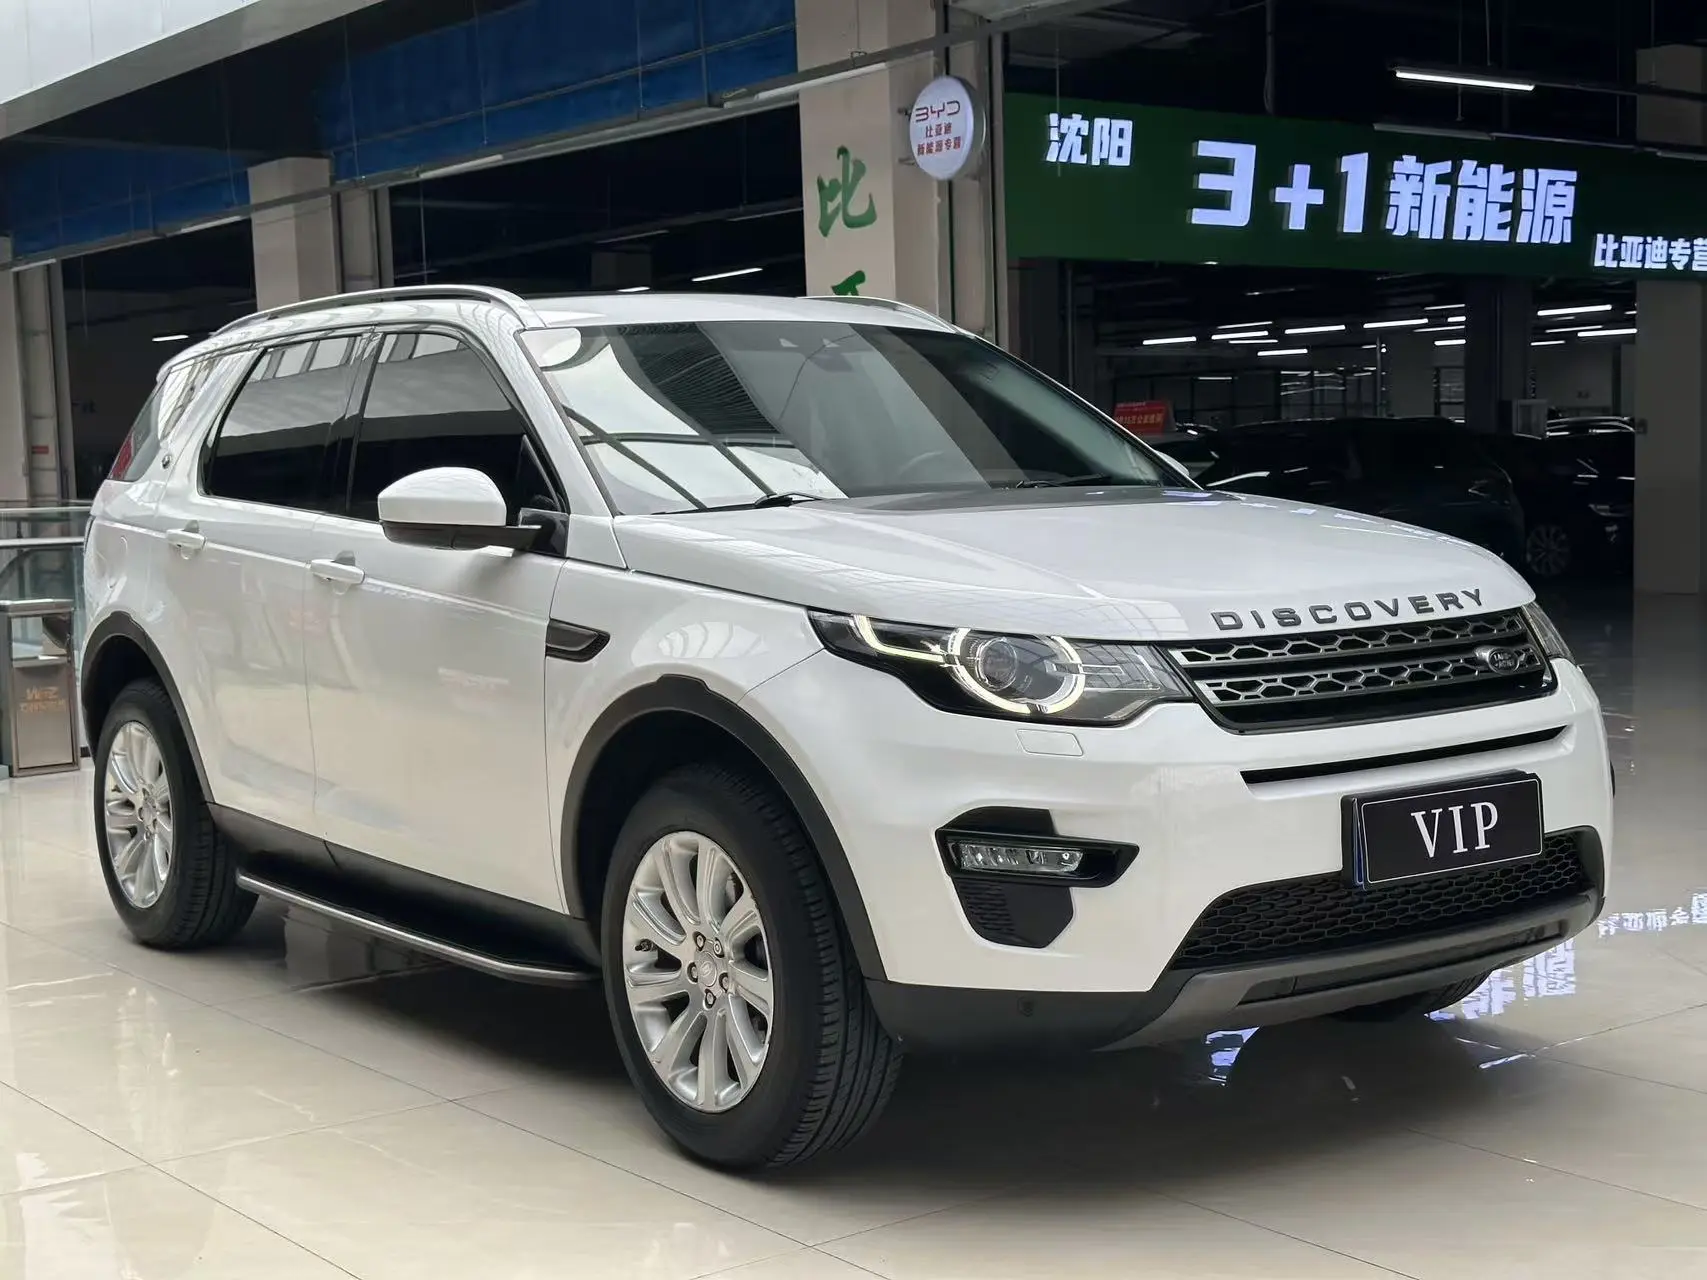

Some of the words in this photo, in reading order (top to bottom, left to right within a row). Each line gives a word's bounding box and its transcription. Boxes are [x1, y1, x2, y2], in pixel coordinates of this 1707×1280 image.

[915, 100, 961, 122] BYD
[1046, 113, 1133, 167] 沈阳
[1211, 588, 1484, 631] DISCOVERY
[1410, 801, 1498, 858] VIP
